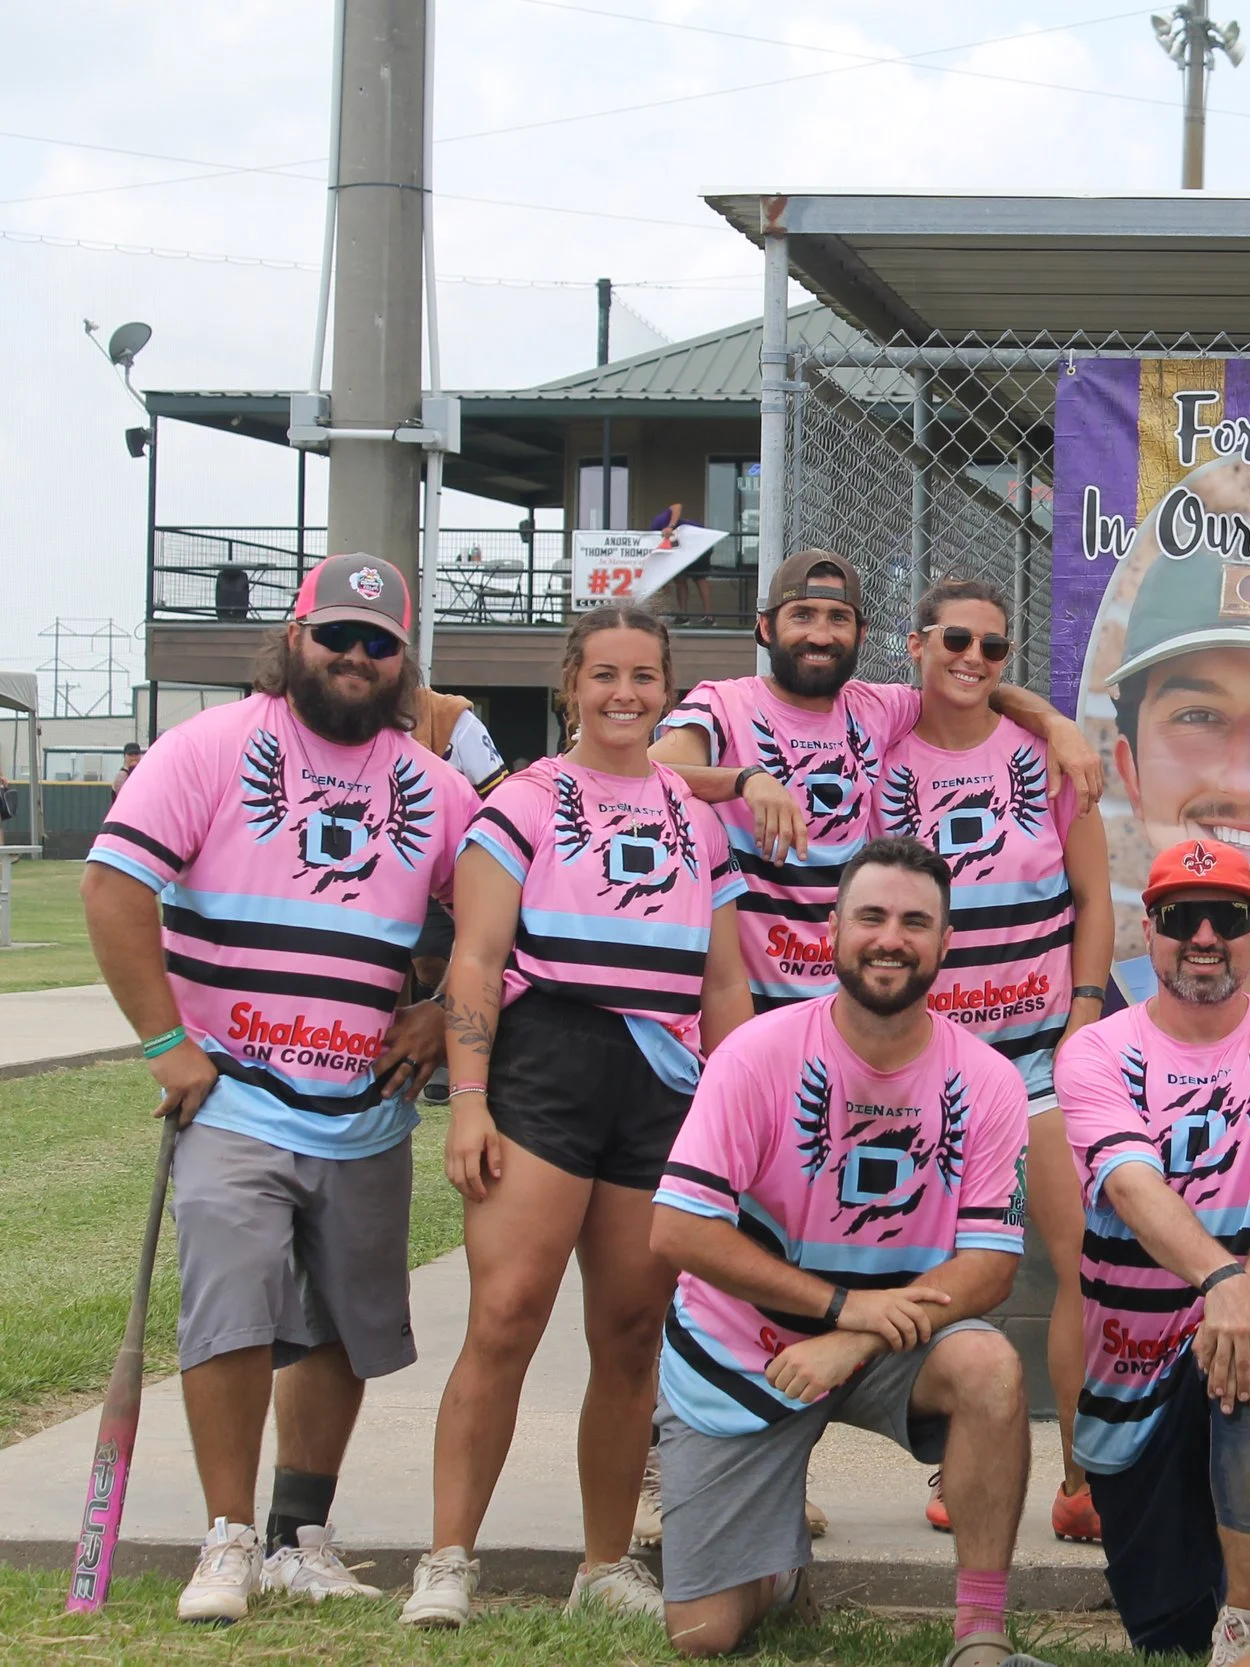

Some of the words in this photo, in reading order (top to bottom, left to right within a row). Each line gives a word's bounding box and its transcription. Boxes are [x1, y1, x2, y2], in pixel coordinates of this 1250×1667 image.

[1083, 486, 1136, 559] In
[604, 537, 641, 546] ANDREW
[780, 961, 804, 976] ON
[928, 971, 1050, 1012] akebacks
[227, 1000, 382, 1059] Shakeback
[242, 1043, 271, 1062] ON
[280, 1048, 374, 1074] CONGRE
[1168, 1069, 1231, 1085] DIENATY
[72, 1464, 116, 1601] PURE
